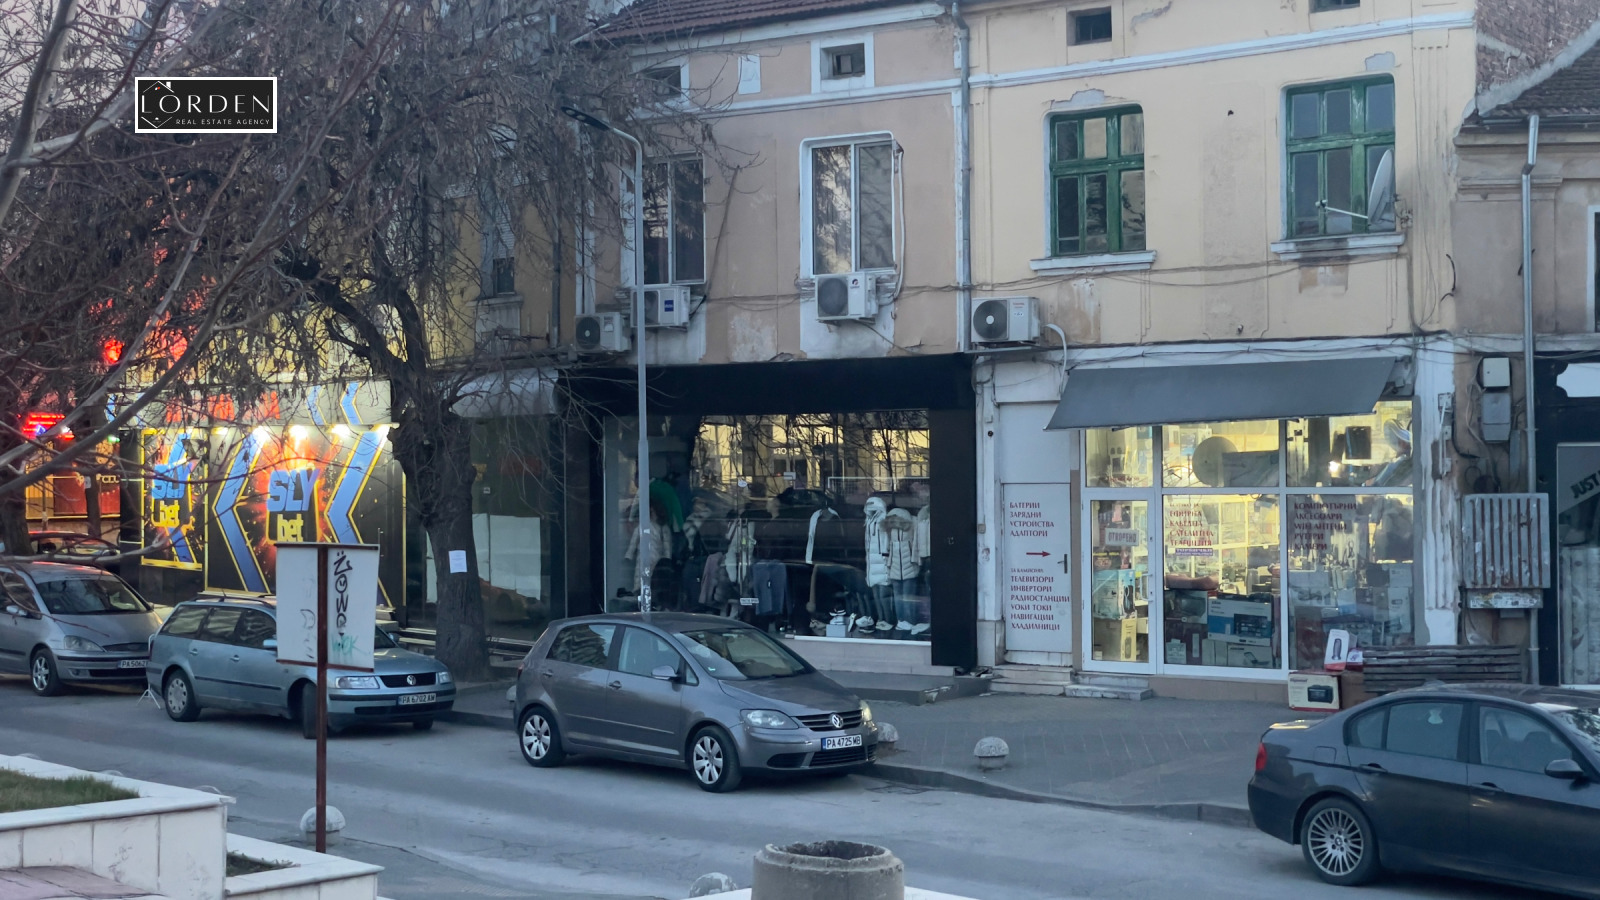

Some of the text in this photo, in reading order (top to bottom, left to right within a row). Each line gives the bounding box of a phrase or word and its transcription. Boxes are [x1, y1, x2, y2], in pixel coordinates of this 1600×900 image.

[152, 463, 191, 499] SLY
[267, 468, 321, 512] SLY
[1570, 472, 1599, 499] JUST
[160, 500, 180, 527] bet
[1010, 511, 1042, 519] ЗАРЯДНИ
[277, 514, 304, 542] bet
[1011, 575, 1054, 583] ТЕЛЕВИЗОРИ
[1011, 594, 1070, 602] РАДИОСТАНЦИИ
[1011, 613, 1054, 621] НАВИГАЦИИ
[827, 739, 836, 748] PA
[837, 737, 852, 747] 4725
